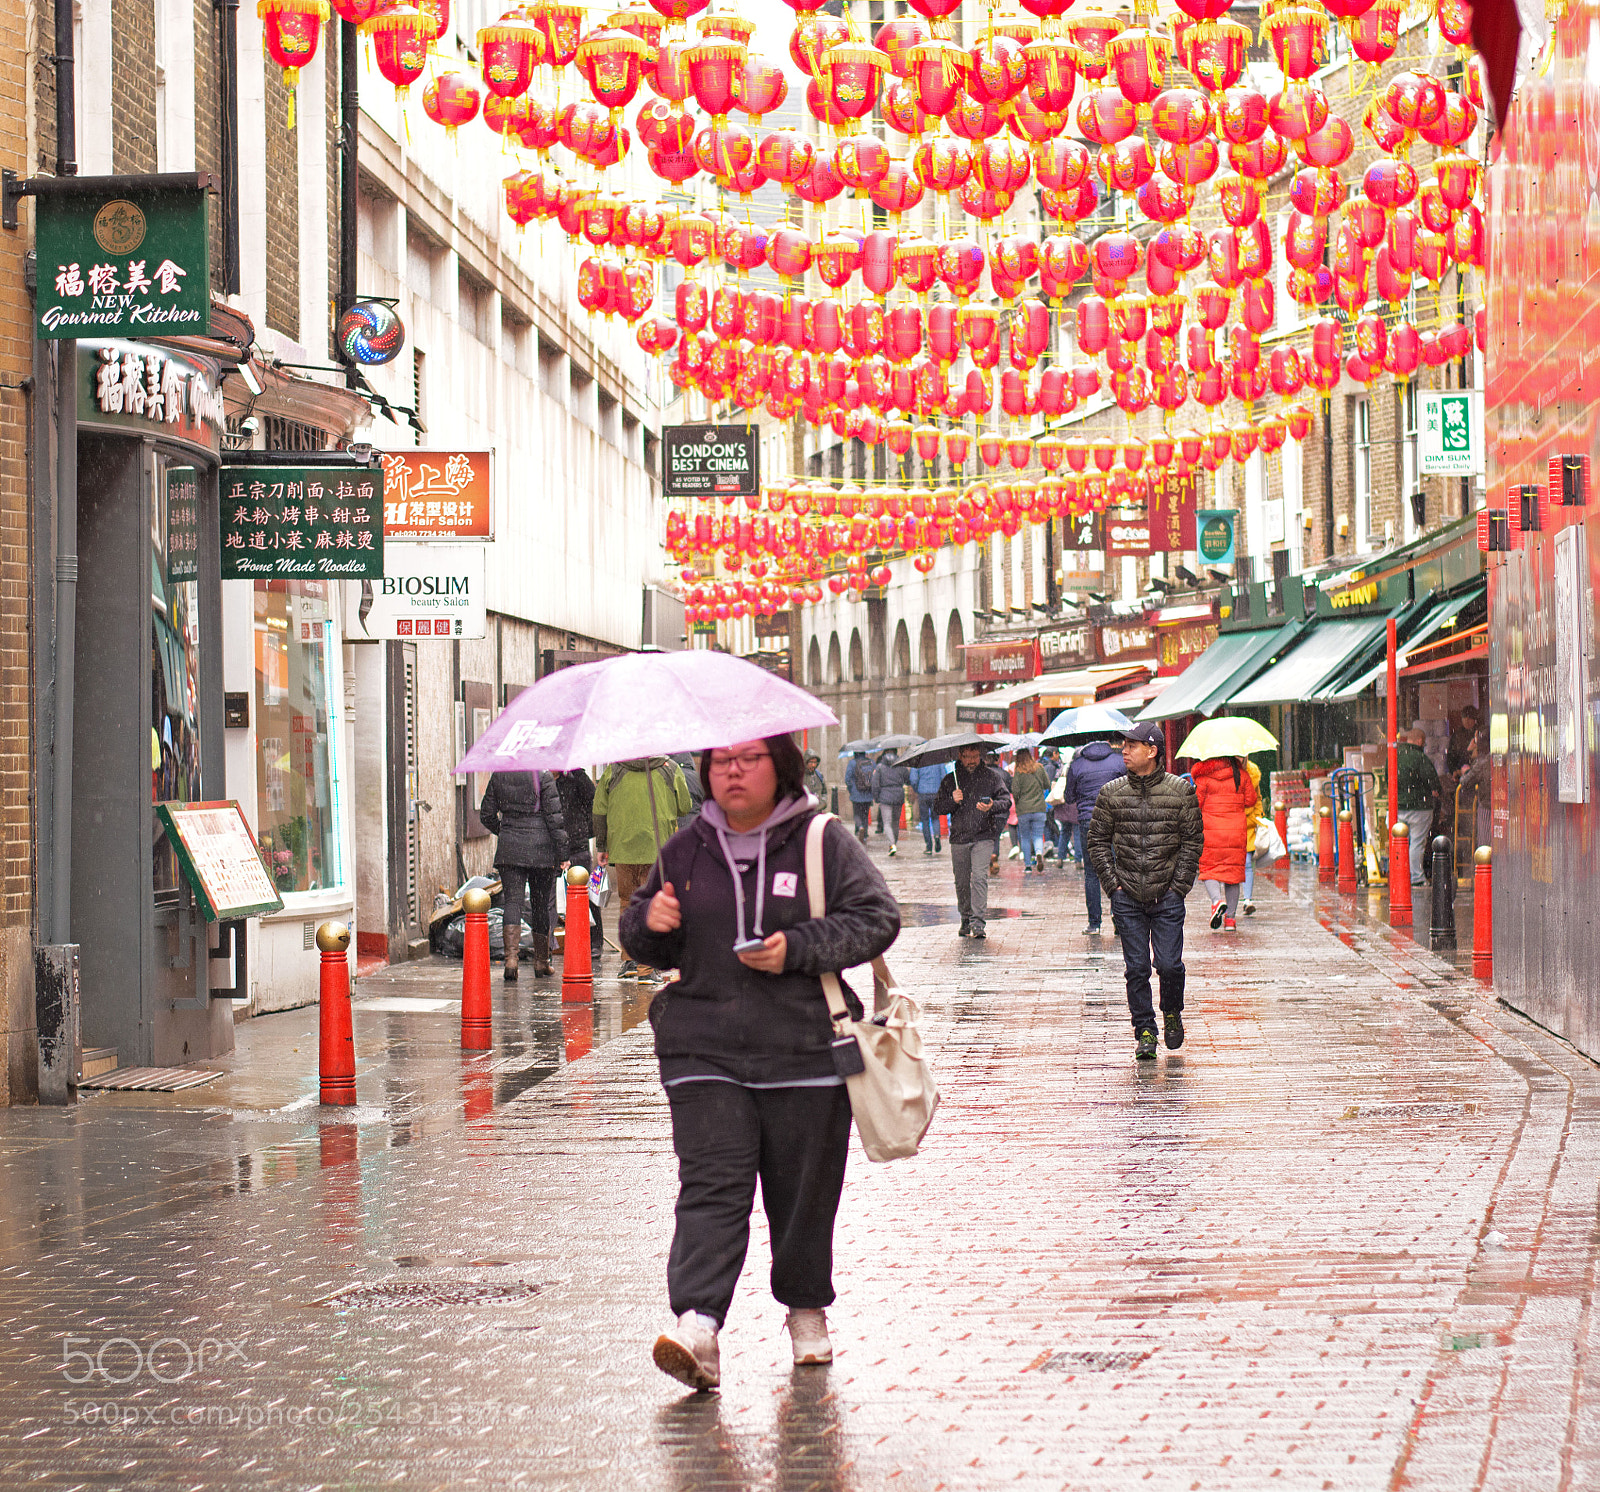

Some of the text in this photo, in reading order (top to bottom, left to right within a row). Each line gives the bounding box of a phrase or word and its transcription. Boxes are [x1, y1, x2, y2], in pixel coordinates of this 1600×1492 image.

[54, 259, 187, 297] 福榕美食
[91, 295, 134, 309] NEW
[41, 303, 201, 332] Gourmet Kitchen
[1426, 402, 1439, 432] 精美
[672, 443, 747, 458] LONDON'S
[1447, 454, 1471, 462] SUM
[672, 458, 750, 471] BEST CINEMA
[228, 481, 374, 500] 正宗刀削面、拉面
[232, 506, 371, 526] 米粉、烤串、甜品
[409, 501, 474, 517] 发型设计
[409, 516, 473, 526] Hair Salon
[225, 530, 375, 551] 地道小菜、麻辣烫
[235, 557, 367, 573] Home Made Noodles
[382, 576, 469, 595] BIOSLIM
[411, 596, 470, 608] beauty Salon
[397, 619, 450, 635] 保麗健
